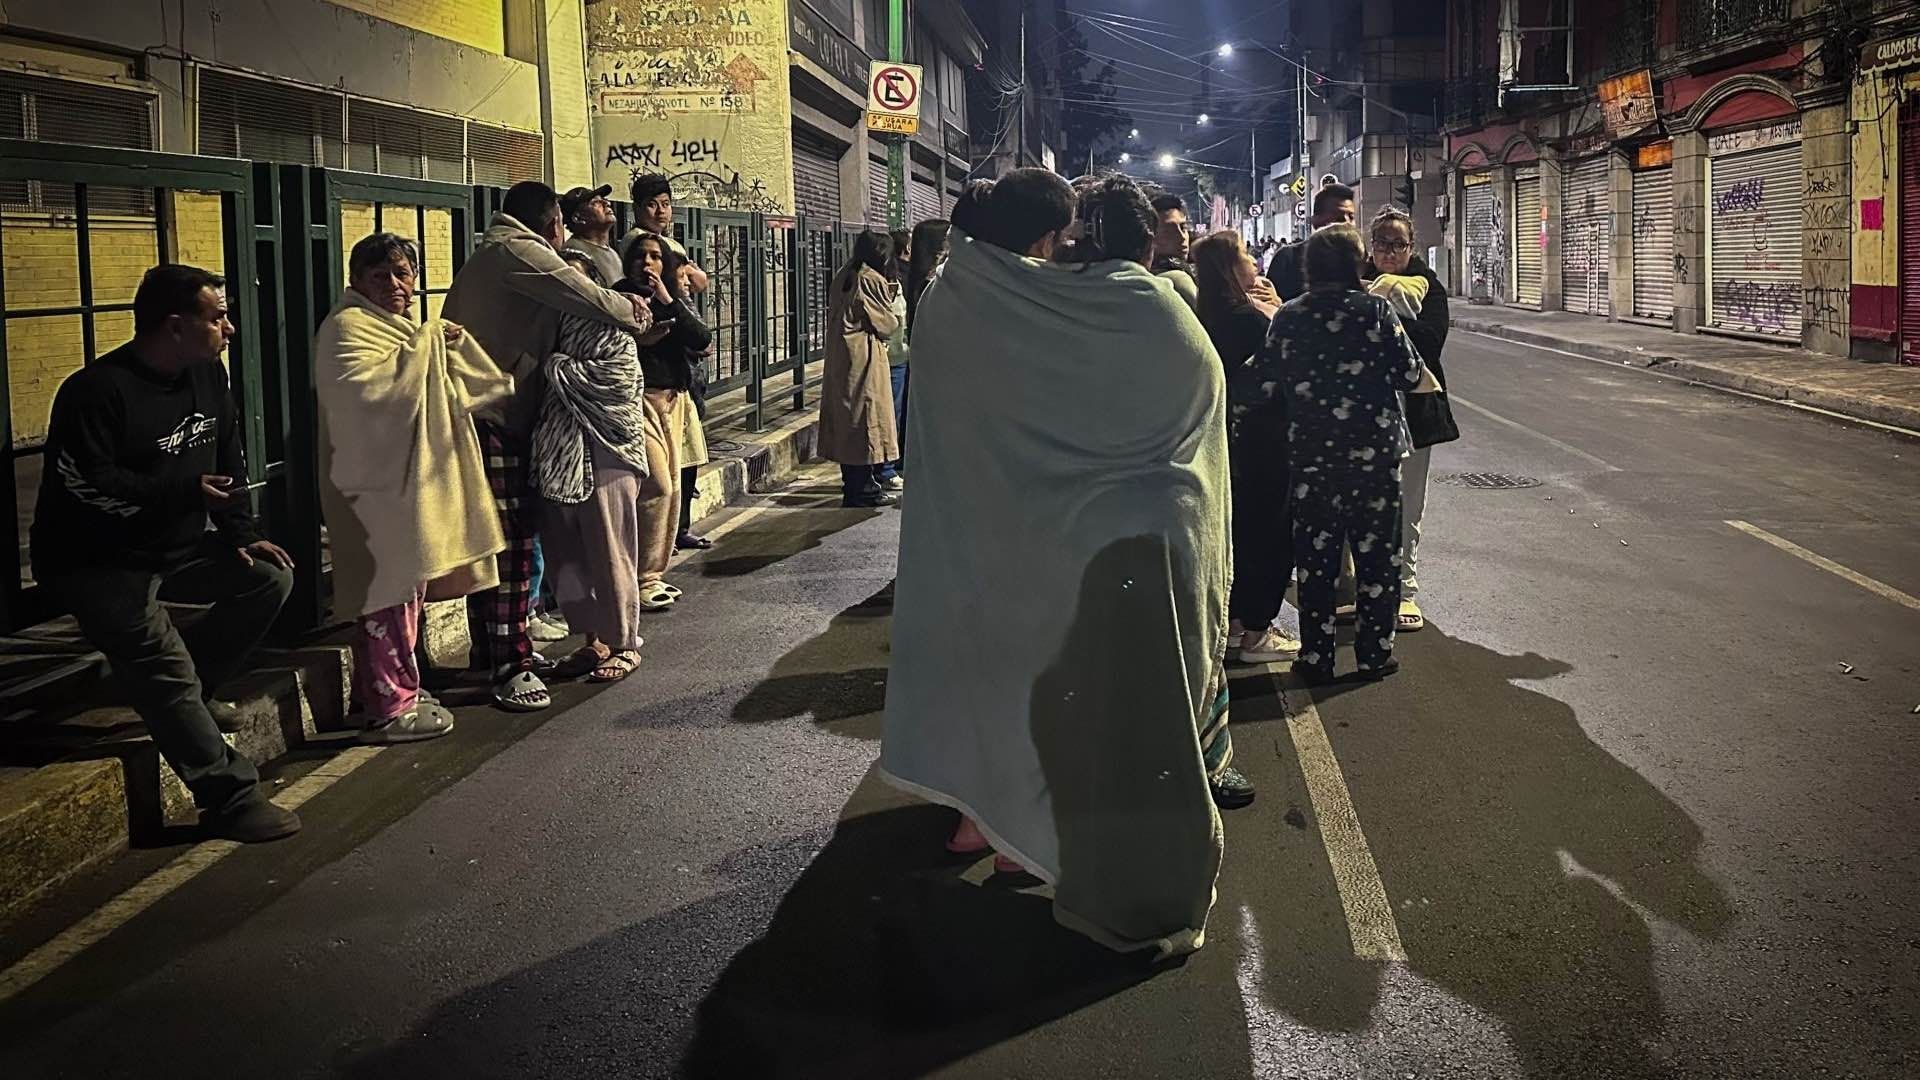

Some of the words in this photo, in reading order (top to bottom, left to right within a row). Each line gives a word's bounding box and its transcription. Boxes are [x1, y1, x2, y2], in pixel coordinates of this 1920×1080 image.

[1877, 40, 1906, 60] CALDOS
[1906, 36, 1918, 53] DE
[608, 97, 690, 110] NEZAHUACOYOTL
[720, 96, 743, 108] 158
[885, 117, 913, 126] USARA
[671, 138, 718, 163] 424
